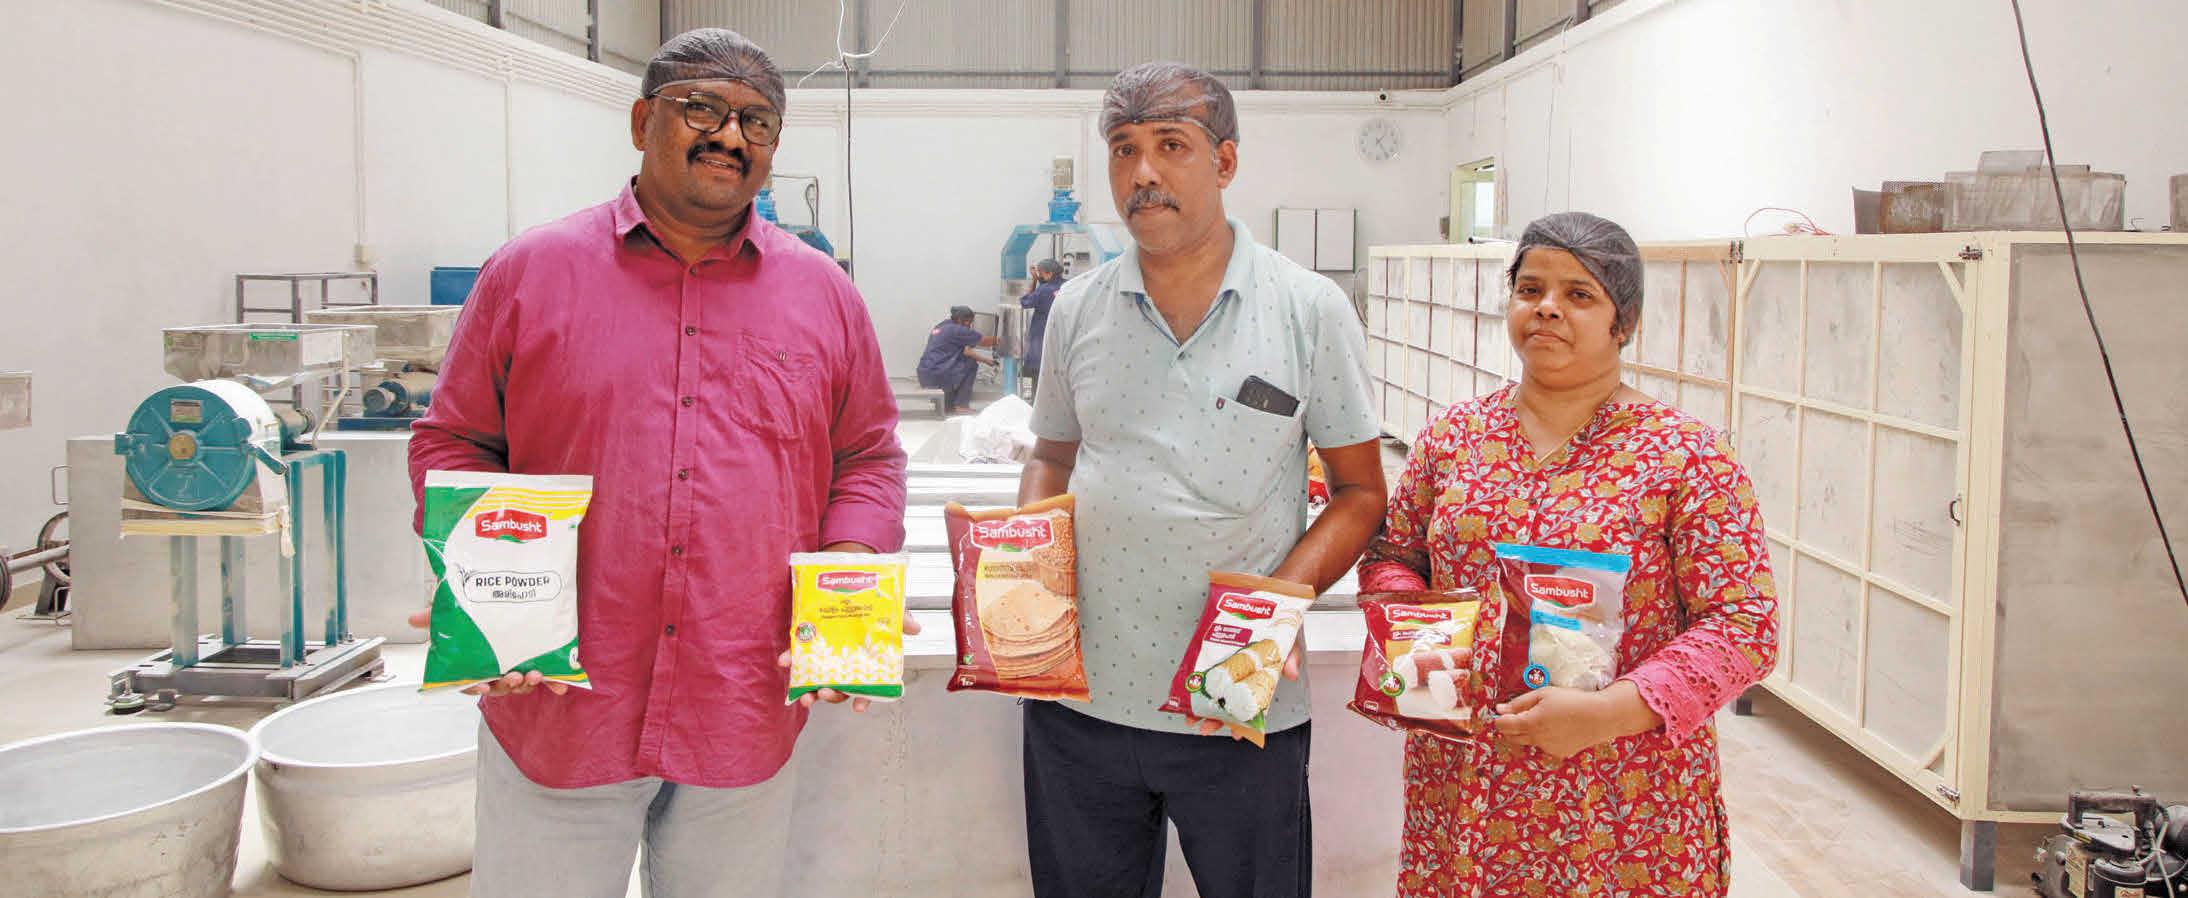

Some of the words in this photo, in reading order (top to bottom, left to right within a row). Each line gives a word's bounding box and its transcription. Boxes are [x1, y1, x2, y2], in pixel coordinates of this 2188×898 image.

[480, 519, 543, 533] Sambusht
[978, 525, 1047, 539] Sambusht
[475, 577, 501, 587] RICE
[505, 576, 551, 587] POWDER
[822, 576, 873, 586] Sambusht
[1530, 582, 1590, 599] Sambusht
[1223, 599, 1272, 616] Sambusht
[1392, 609, 1448, 620] Sambusht
